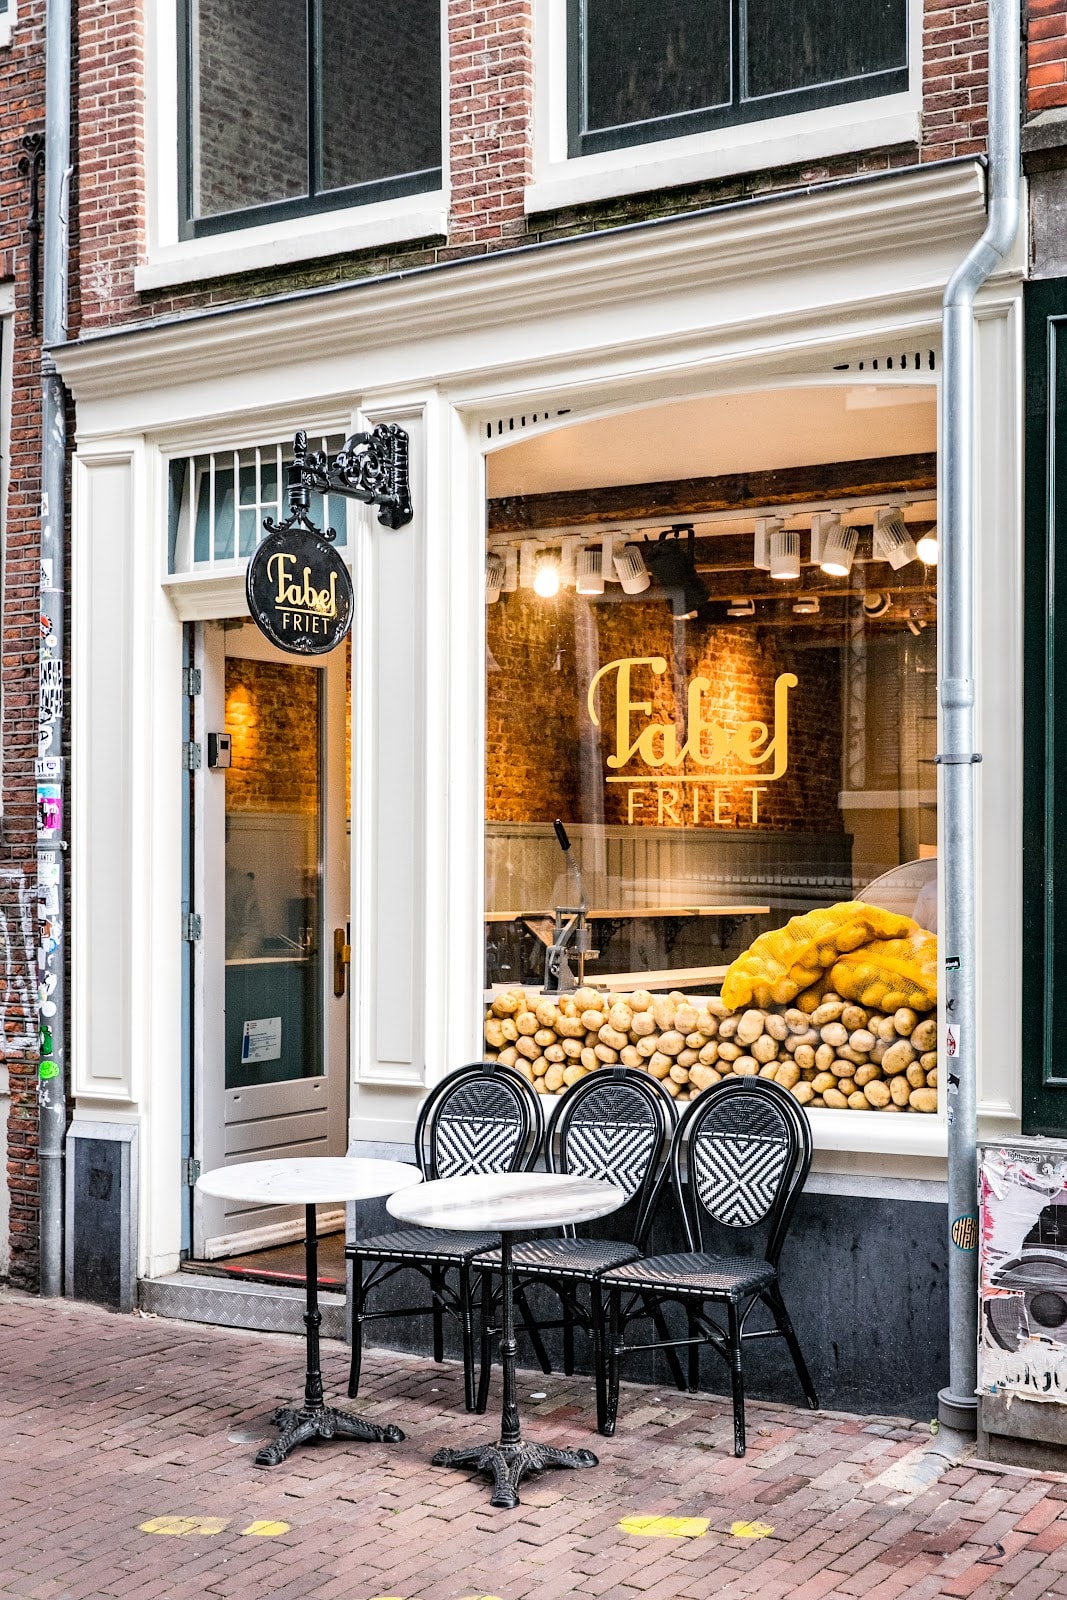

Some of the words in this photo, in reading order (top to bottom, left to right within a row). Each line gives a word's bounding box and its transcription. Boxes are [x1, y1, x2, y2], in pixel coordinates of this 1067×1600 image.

[267, 552, 338, 618] Fabel
[282, 612, 331, 634] FRIET
[587, 656, 799, 782] Fabel
[627, 786, 768, 824] FRIET
